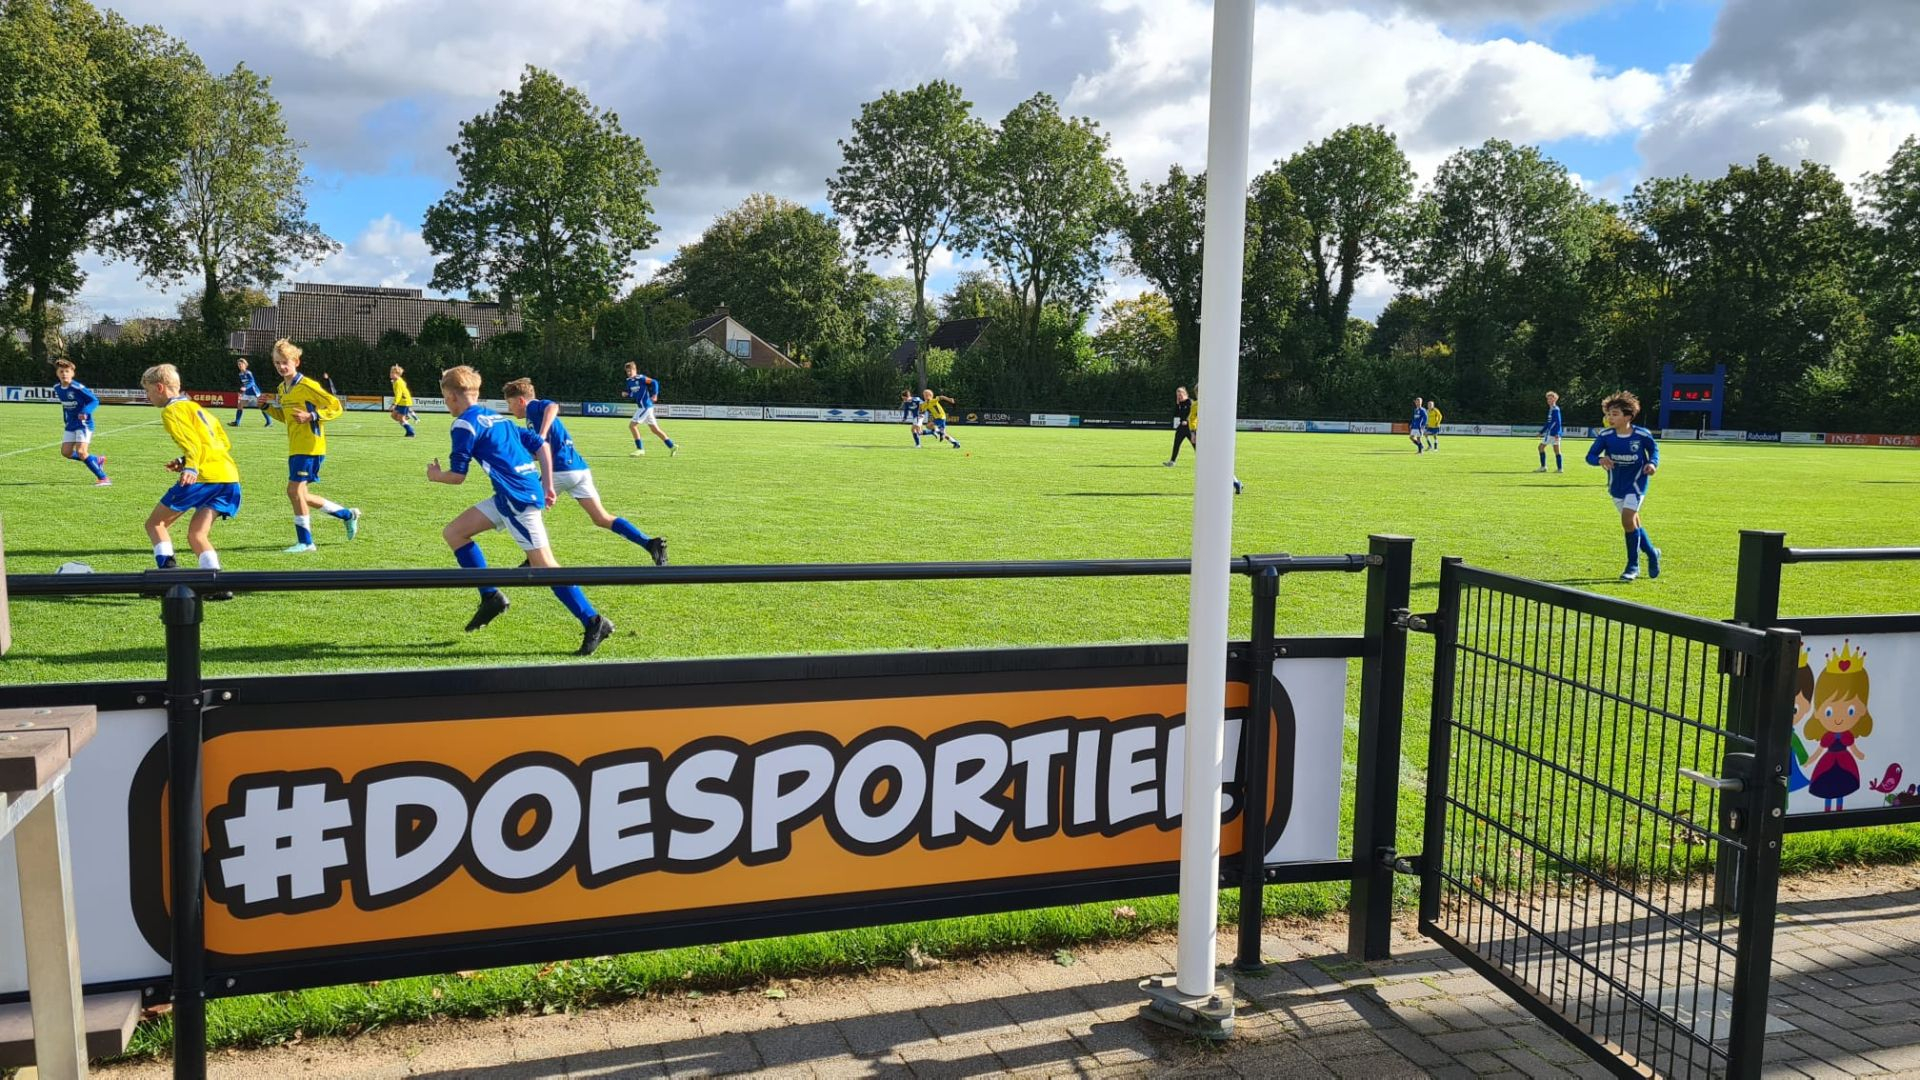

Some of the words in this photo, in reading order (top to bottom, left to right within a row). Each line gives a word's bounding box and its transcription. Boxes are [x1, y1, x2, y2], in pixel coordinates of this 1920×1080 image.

[588, 404, 609, 413] kab
[1747, 432, 1778, 441] Rabobank
[1831, 435, 1852, 443] ING
[1878, 436, 1901, 445] ING
